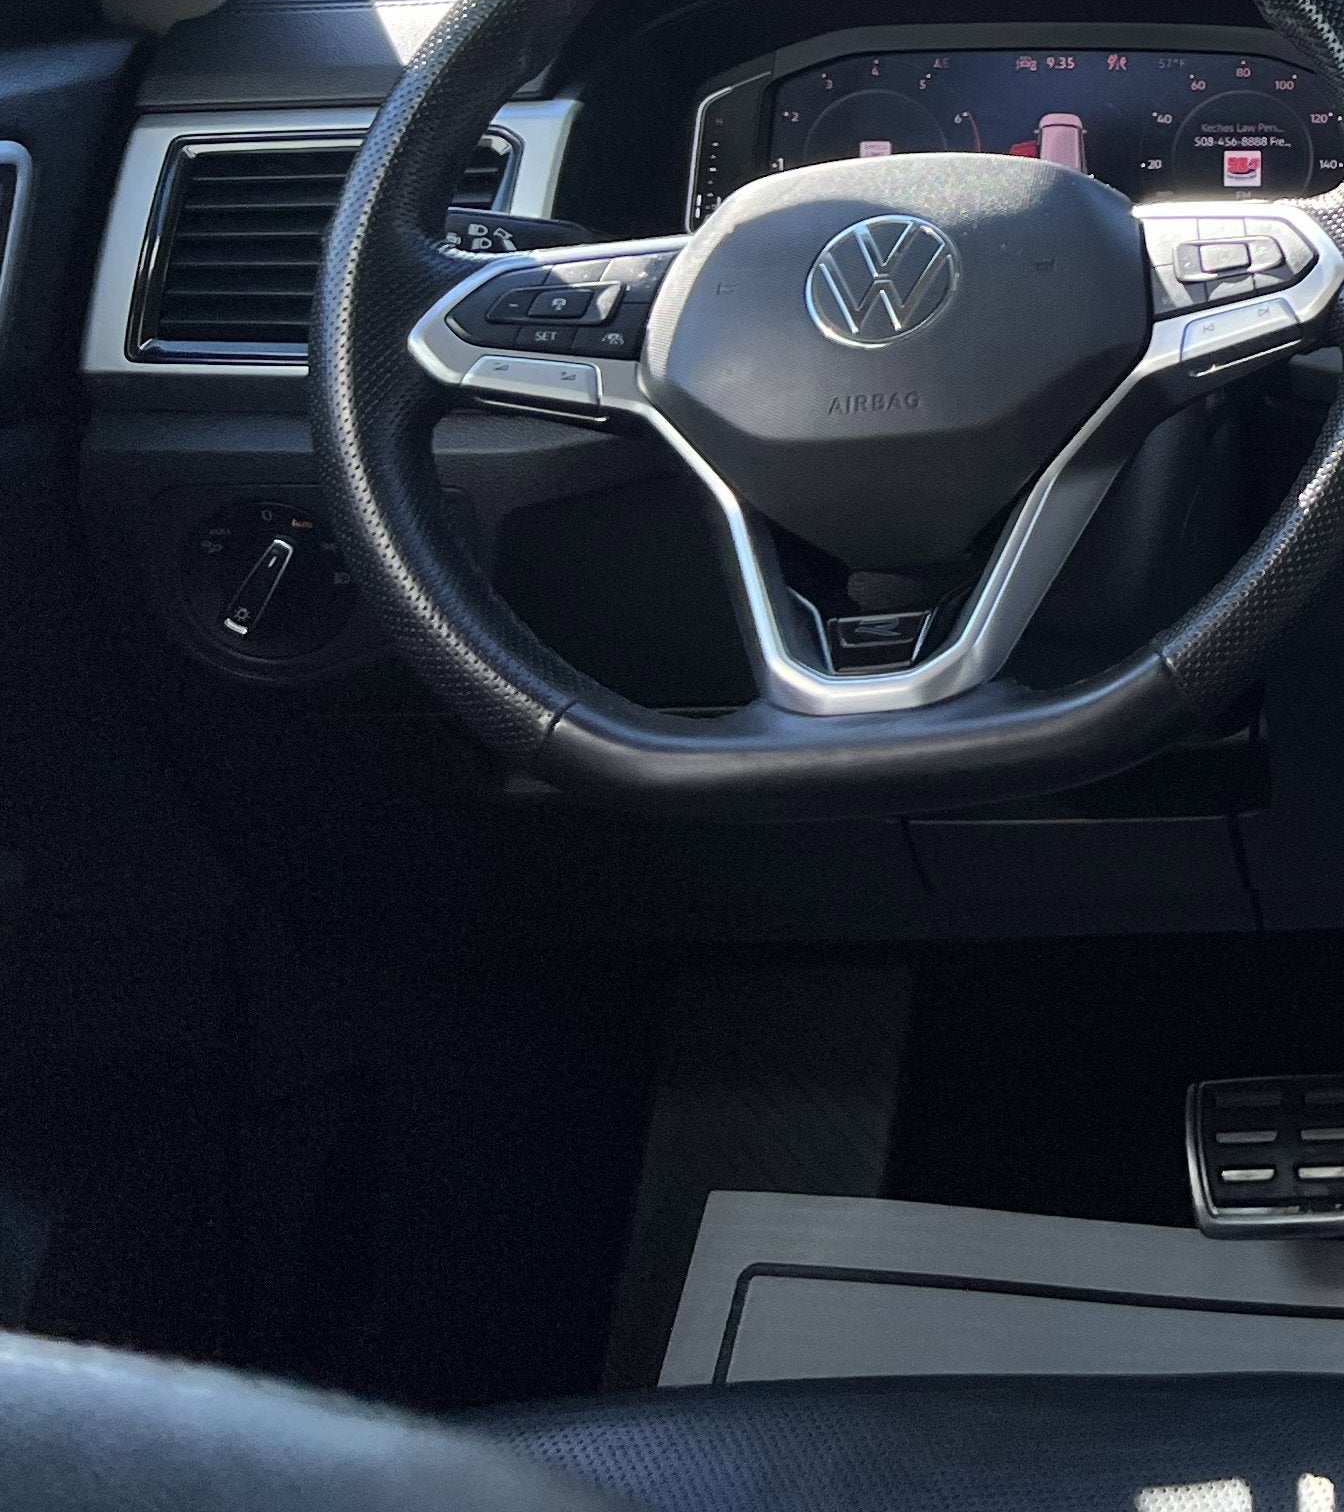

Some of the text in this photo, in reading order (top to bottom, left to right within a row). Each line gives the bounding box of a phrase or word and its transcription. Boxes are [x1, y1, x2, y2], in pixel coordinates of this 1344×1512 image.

[1235, 67, 1251, 78] 80
[1189, 80, 1207, 91] 60
[1274, 80, 1295, 91] 100
[1156, 113, 1173, 124] 40
[1310, 113, 1329, 123] 120
[1147, 159, 1163, 170] 20
[1319, 159, 1338, 170] 140
[535, 331, 557, 342] SET
[828, 390, 921, 415] AIRBAG
